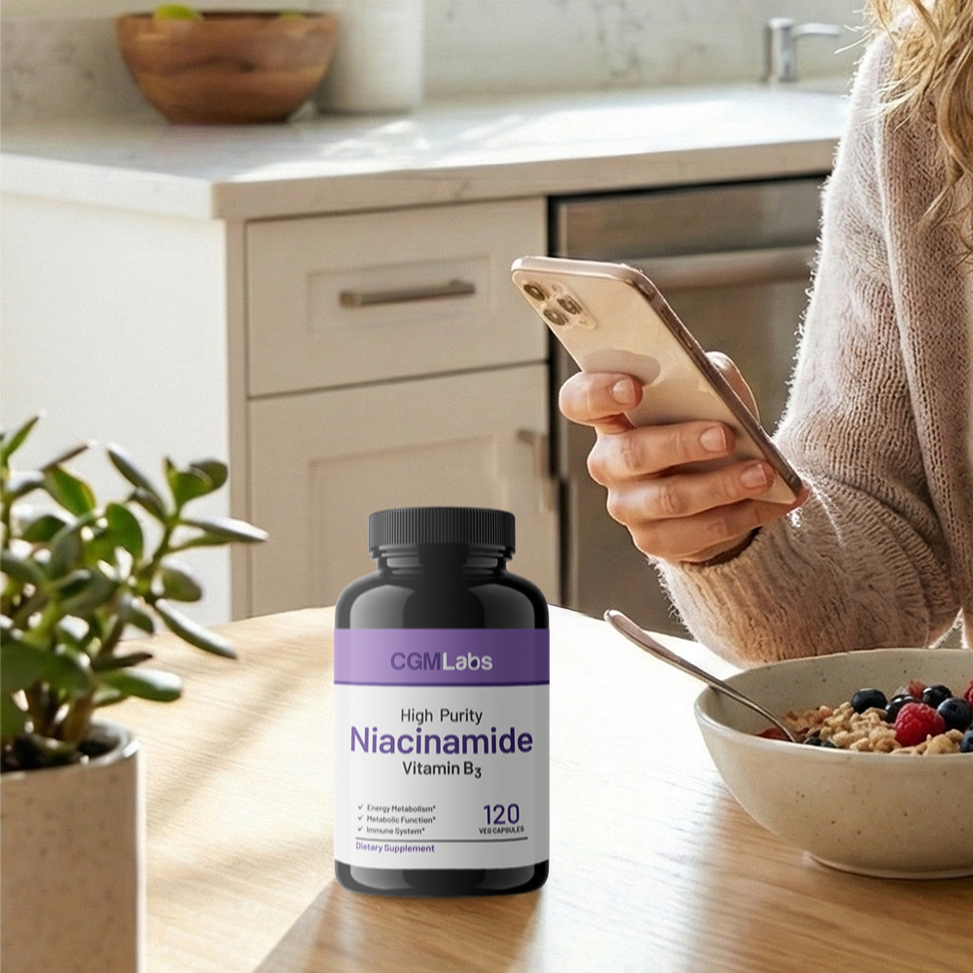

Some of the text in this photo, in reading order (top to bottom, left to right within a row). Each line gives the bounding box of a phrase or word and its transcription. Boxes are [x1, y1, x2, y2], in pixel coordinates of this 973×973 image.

[390, 651, 493, 671] CGMLabs
[400, 708, 483, 726] High Purity
[350, 726, 534, 755] Niacinamide
[402, 761, 461, 776] Vitamin
[367, 804, 391, 814] Energy
[483, 803, 520, 825] 120
[366, 815, 400, 825] Metabolic
[366, 826, 394, 835] Immune
[479, 825, 525, 835] VEG CAPSULES
[355, 841, 435, 854] Dietary Supplement
